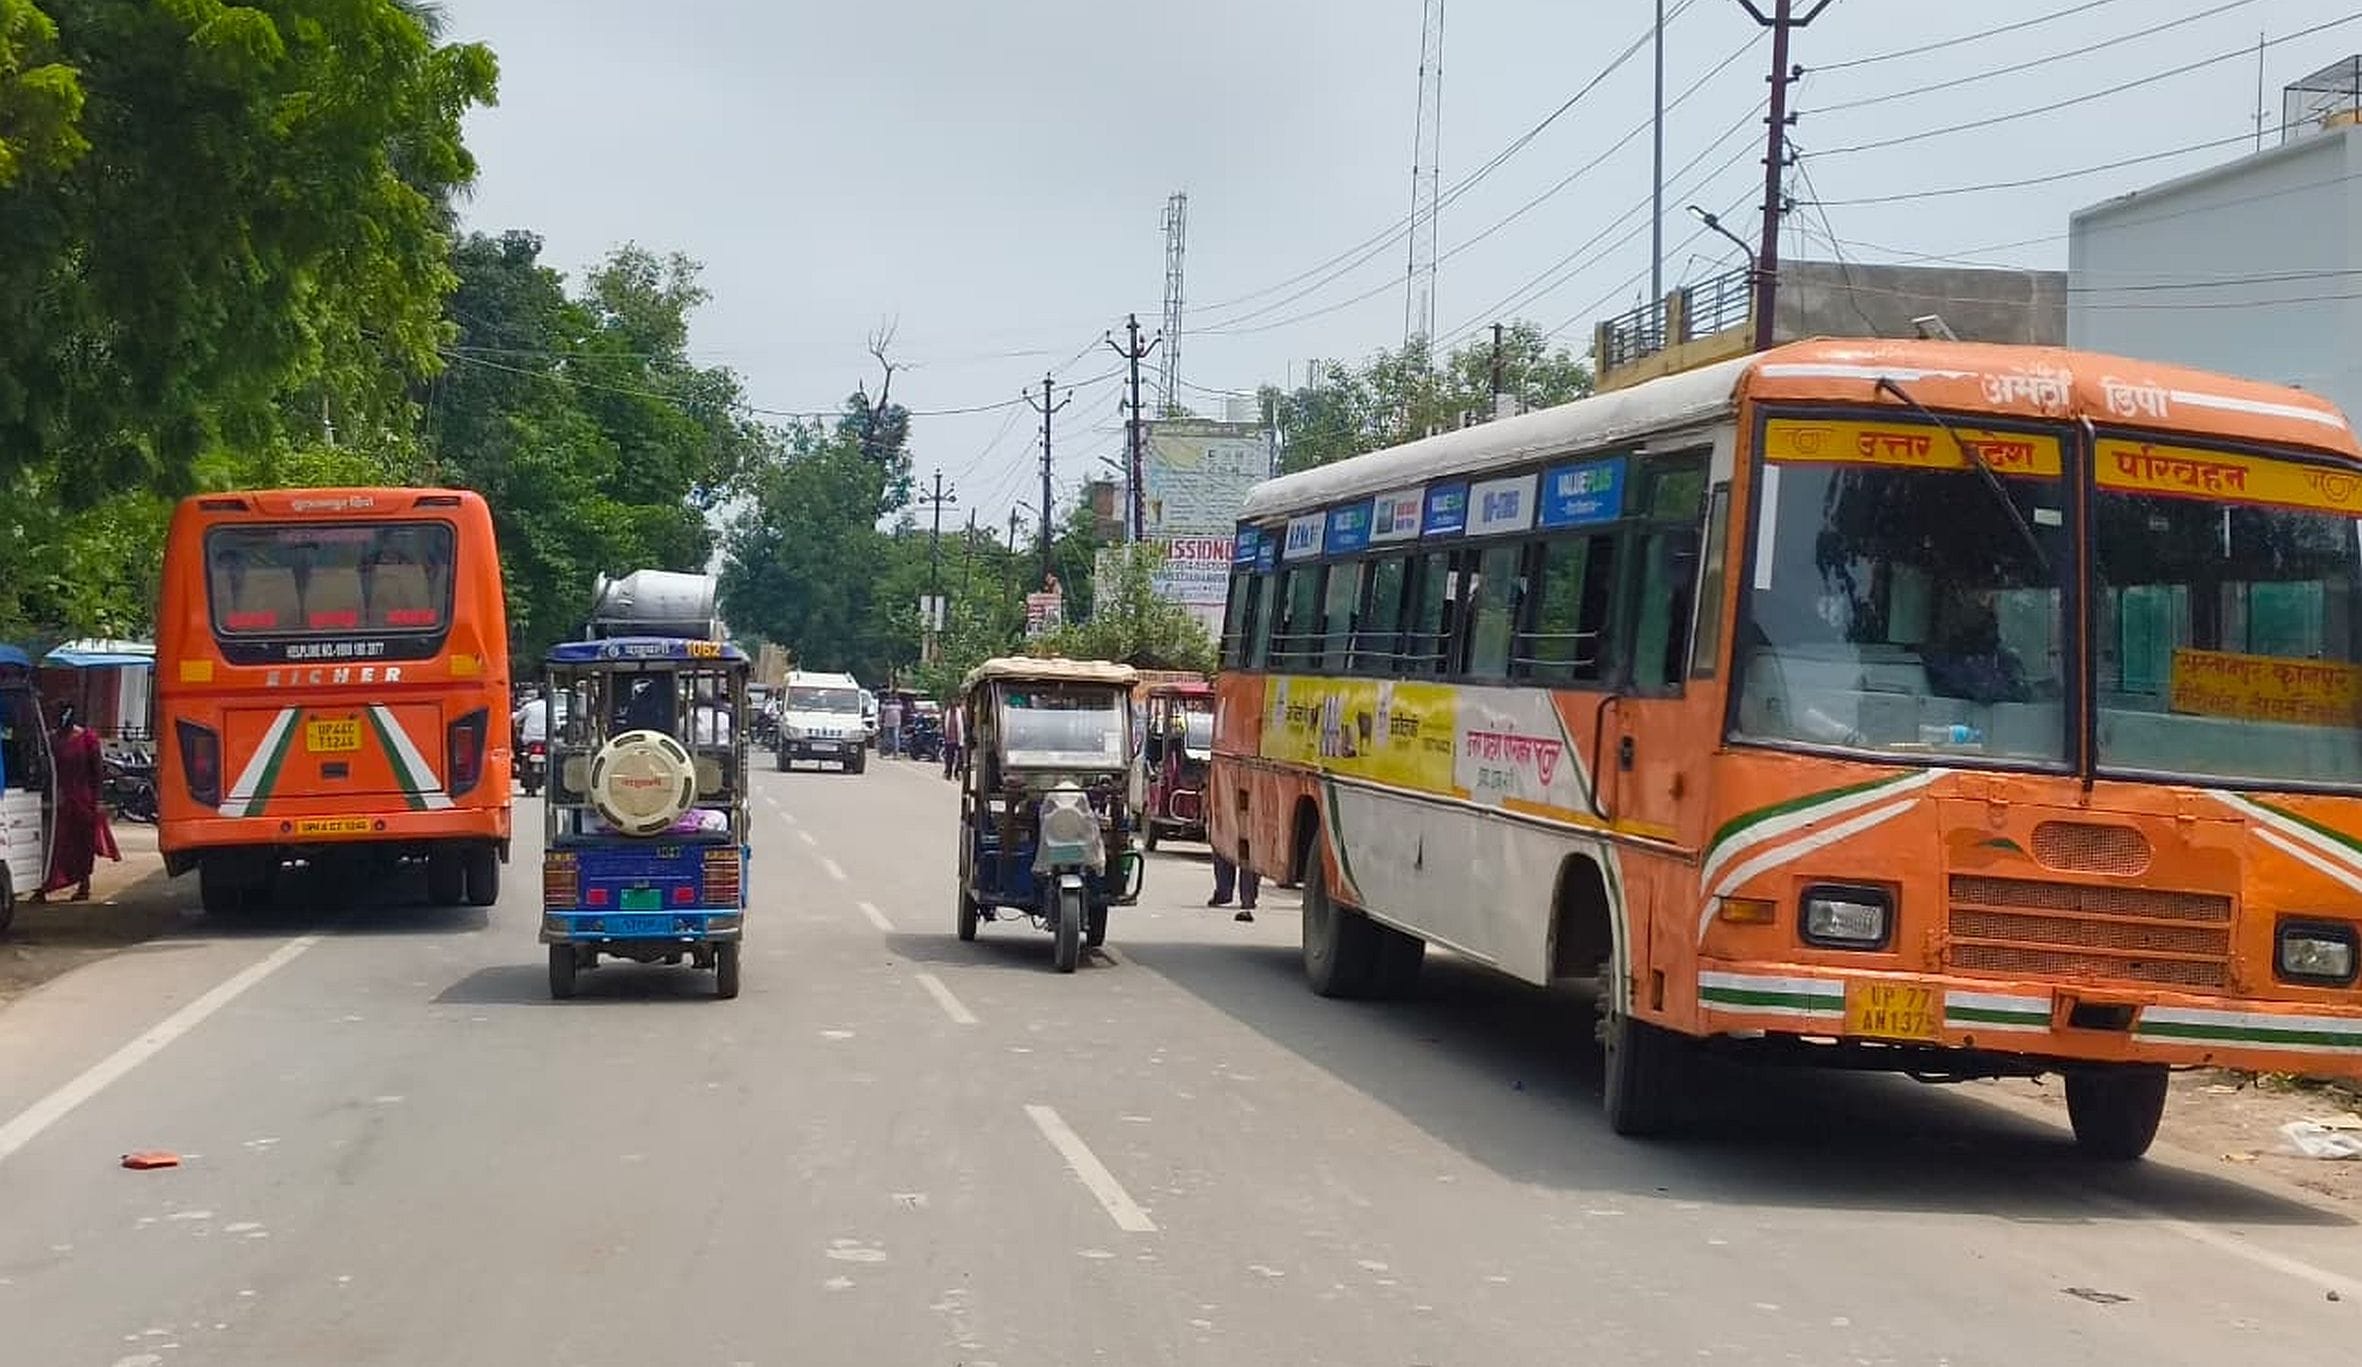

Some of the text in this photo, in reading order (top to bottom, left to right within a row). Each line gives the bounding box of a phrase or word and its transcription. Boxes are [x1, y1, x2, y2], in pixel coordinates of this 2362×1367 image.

[1859, 431, 1931, 458] उत्तर
[2111, 443, 2250, 492] परिवहन
[686, 640, 721, 658] 1062
[266, 666, 401, 687] EICHER
